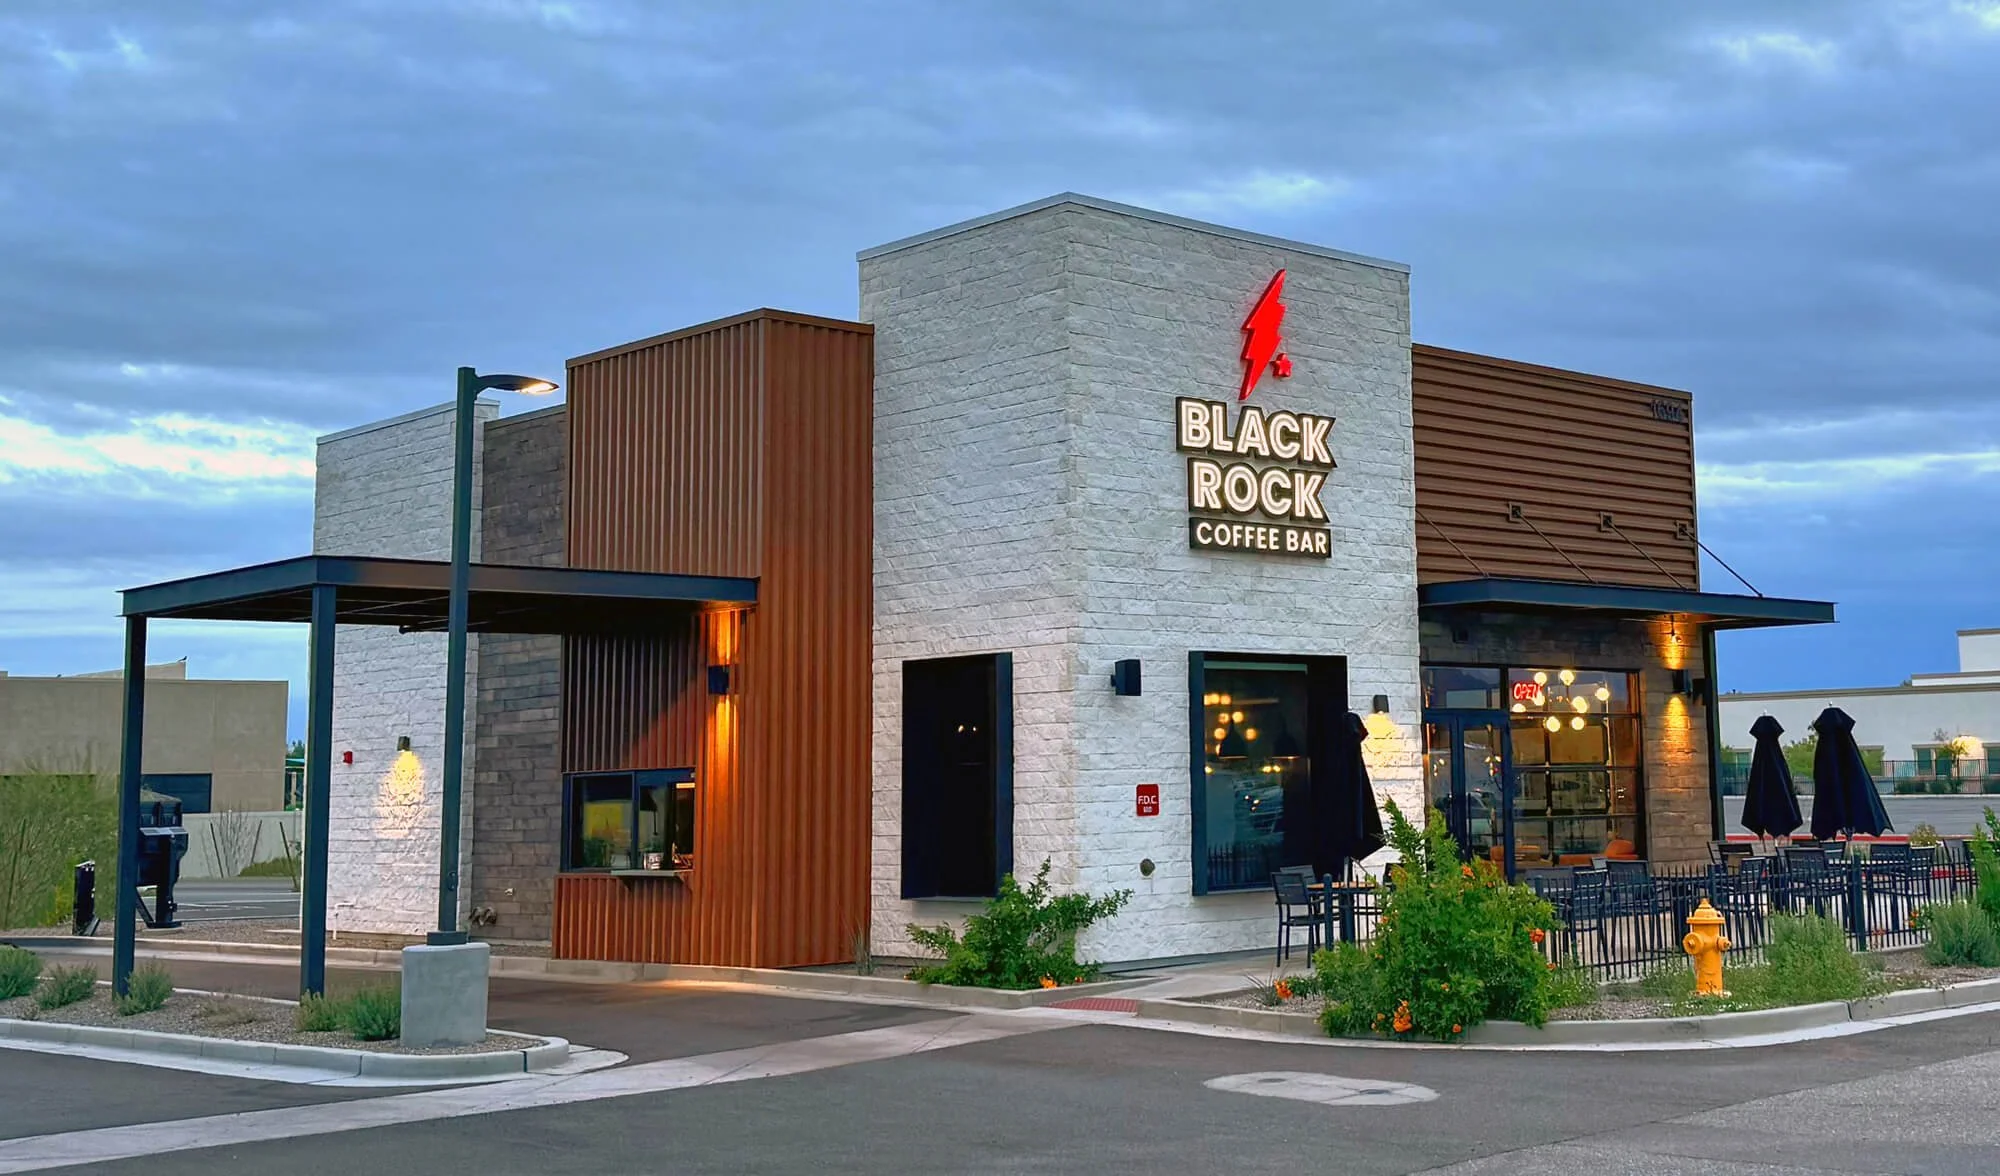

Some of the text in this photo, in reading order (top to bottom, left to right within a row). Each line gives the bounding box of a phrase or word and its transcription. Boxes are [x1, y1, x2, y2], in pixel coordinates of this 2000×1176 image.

[1180, 399, 1332, 464] BLACK
[1192, 461, 1325, 519] ROCK
[1196, 522, 1327, 554] COFFEE BAR
